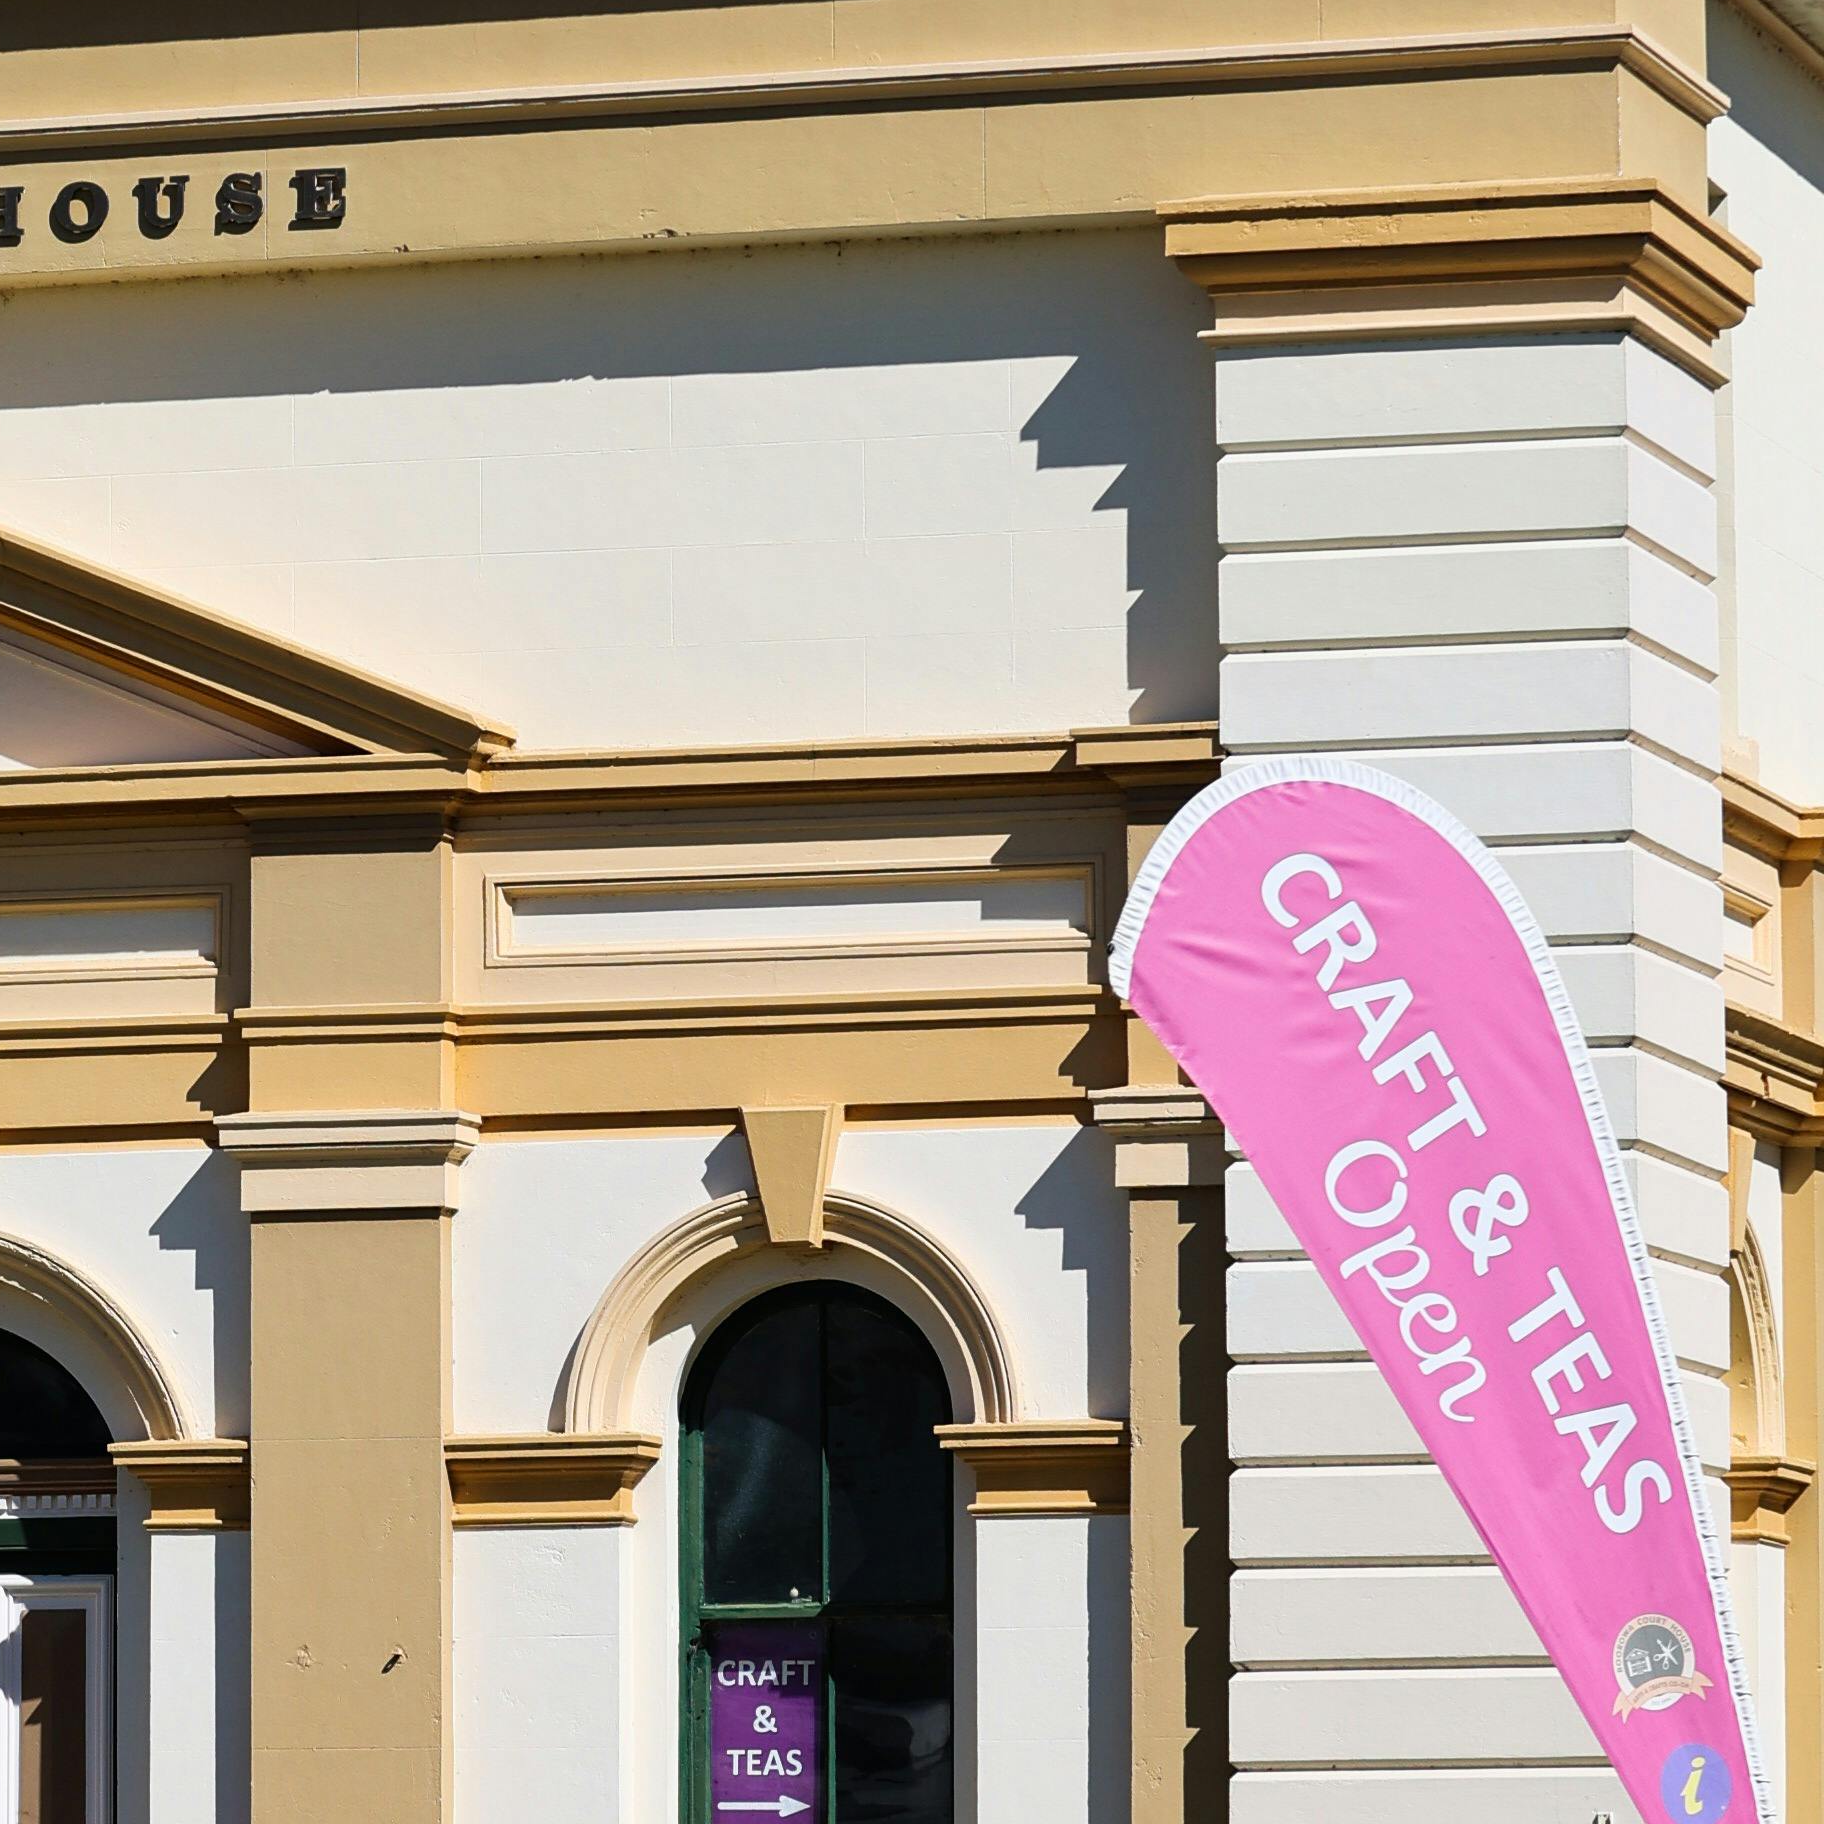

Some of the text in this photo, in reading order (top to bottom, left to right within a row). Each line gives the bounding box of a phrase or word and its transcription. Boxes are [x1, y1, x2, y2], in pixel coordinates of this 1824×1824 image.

[1260, 852, 1672, 1534] CRAFT & TEAS
[1324, 1139, 1488, 1423] Open
[1636, 1616, 1667, 1626] COURT
[1670, 1623, 1692, 1653] HOUSE
[716, 1659, 816, 1687] CRAFT
[752, 1705, 778, 1734] &
[726, 1748, 803, 1777] TEAS
